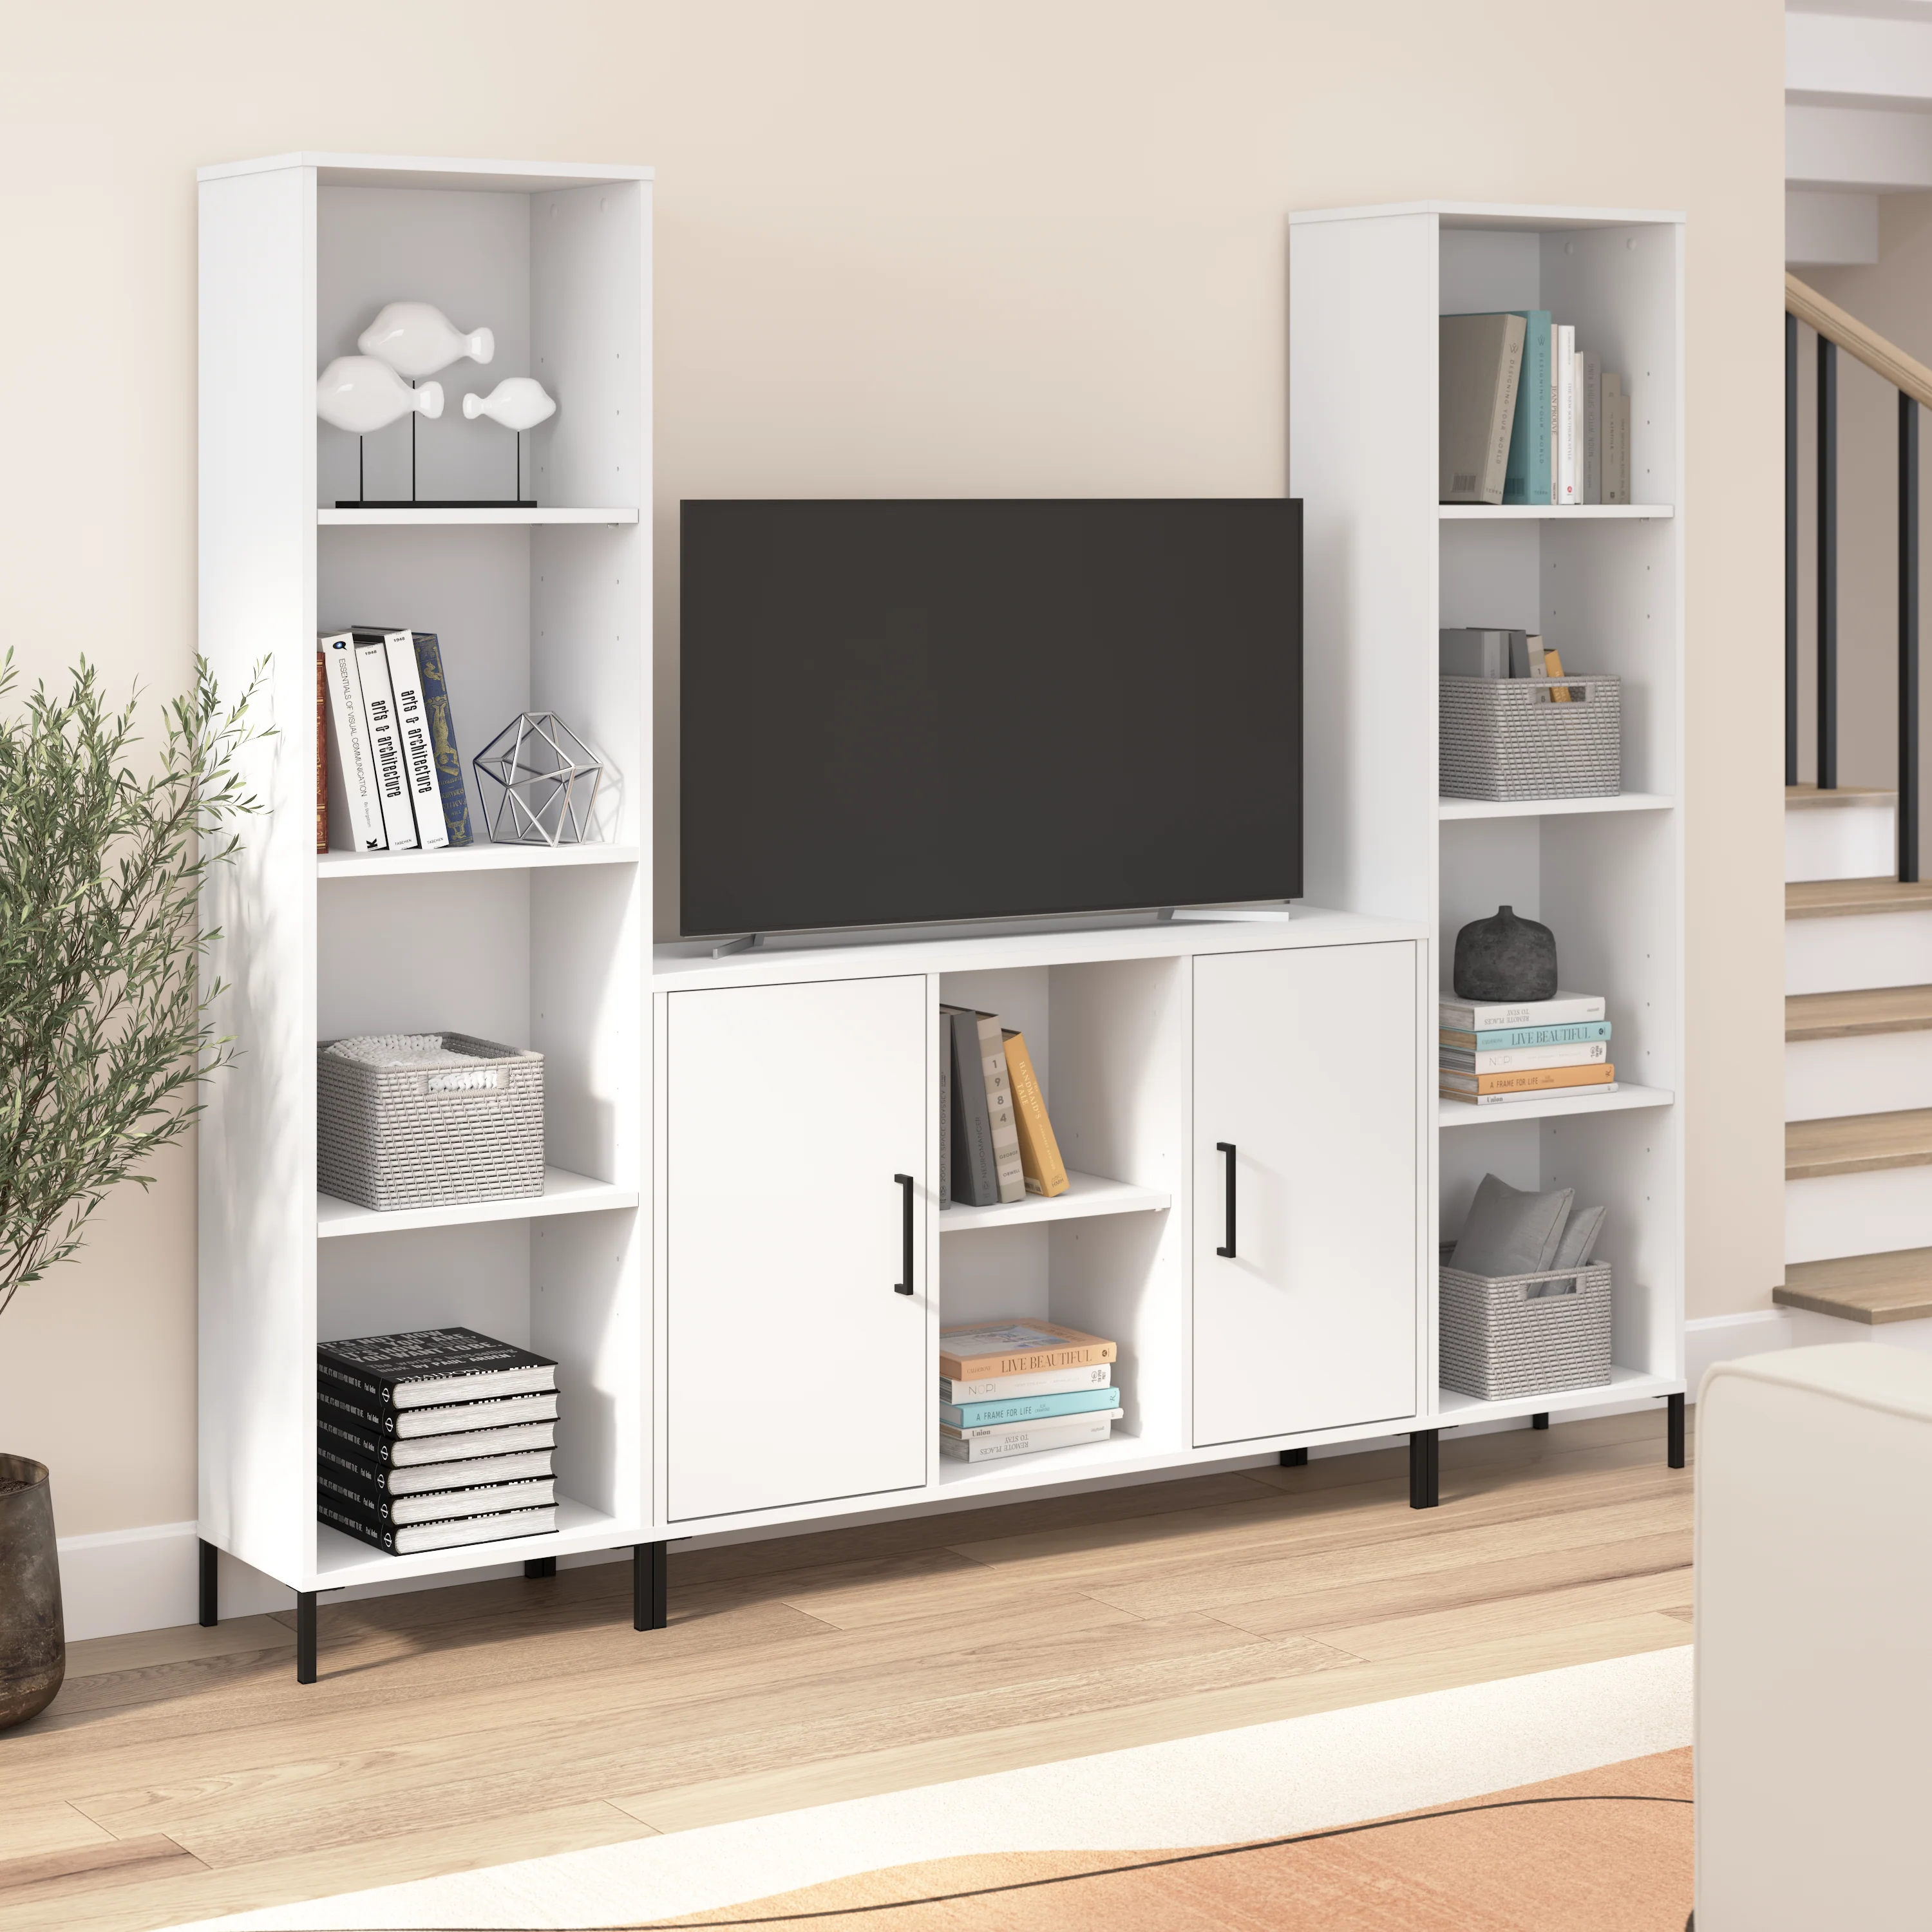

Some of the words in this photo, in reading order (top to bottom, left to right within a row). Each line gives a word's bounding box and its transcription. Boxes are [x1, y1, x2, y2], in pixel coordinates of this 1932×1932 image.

[1504, 359, 1515, 404] DESIGNING
[339, 658, 352, 699] ESSENTIALS
[346, 701, 354, 710] OF
[372, 701, 389, 721] arts
[401, 690, 418, 712] arts
[348, 711, 357, 736] VISUAL
[352, 737, 368, 797] COMMUNICATION
[377, 736, 401, 797] architecture
[408, 728, 431, 793] architecture
[1511, 1032, 1533, 1045] LIVE
[1536, 1027, 1591, 1043] BEAUTIFUL
[1017, 1083, 1028, 1106] TALE
[1019, 1061, 1041, 1119] HANDMAID'S
[976, 1117, 987, 1179] NEUROMANCER
[999, 1150, 1018, 1160] GEORGE
[1003, 1169, 1020, 1177] ORWELL
[1052, 1178, 1064, 1188] HMH
[317, 1341, 356, 1350] IT'S
[356, 1336, 395, 1345] NOT
[399, 1330, 444, 1340] HOW
[328, 1344, 381, 1353] GOOD
[383, 1338, 425, 1347] YOU
[431, 1333, 477, 1342] ARE,
[338, 1350, 379, 1358] IT'S
[379, 1344, 424, 1354] HOW
[426, 1338, 478, 1348] GOOD
[348, 1354, 392, 1363] YOU
[389, 1348, 444, 1358] WANT
[395, 1358, 443, 1366] world's
[468, 1354, 516, 1362] ARDEN.
[1001, 1358, 1027, 1372] LIVE
[1030, 1350, 1092, 1369] BEAUTIFUL
[395, 1368, 480, 1381] PHAIDON
[969, 1384, 996, 1396] NOPI
[984, 1410, 1003, 1419] FRAME
[1020, 1406, 1032, 1415] LIFE
[980, 1446, 1001, 1455] PLACES
[1004, 1442, 1028, 1451] REMOTE
